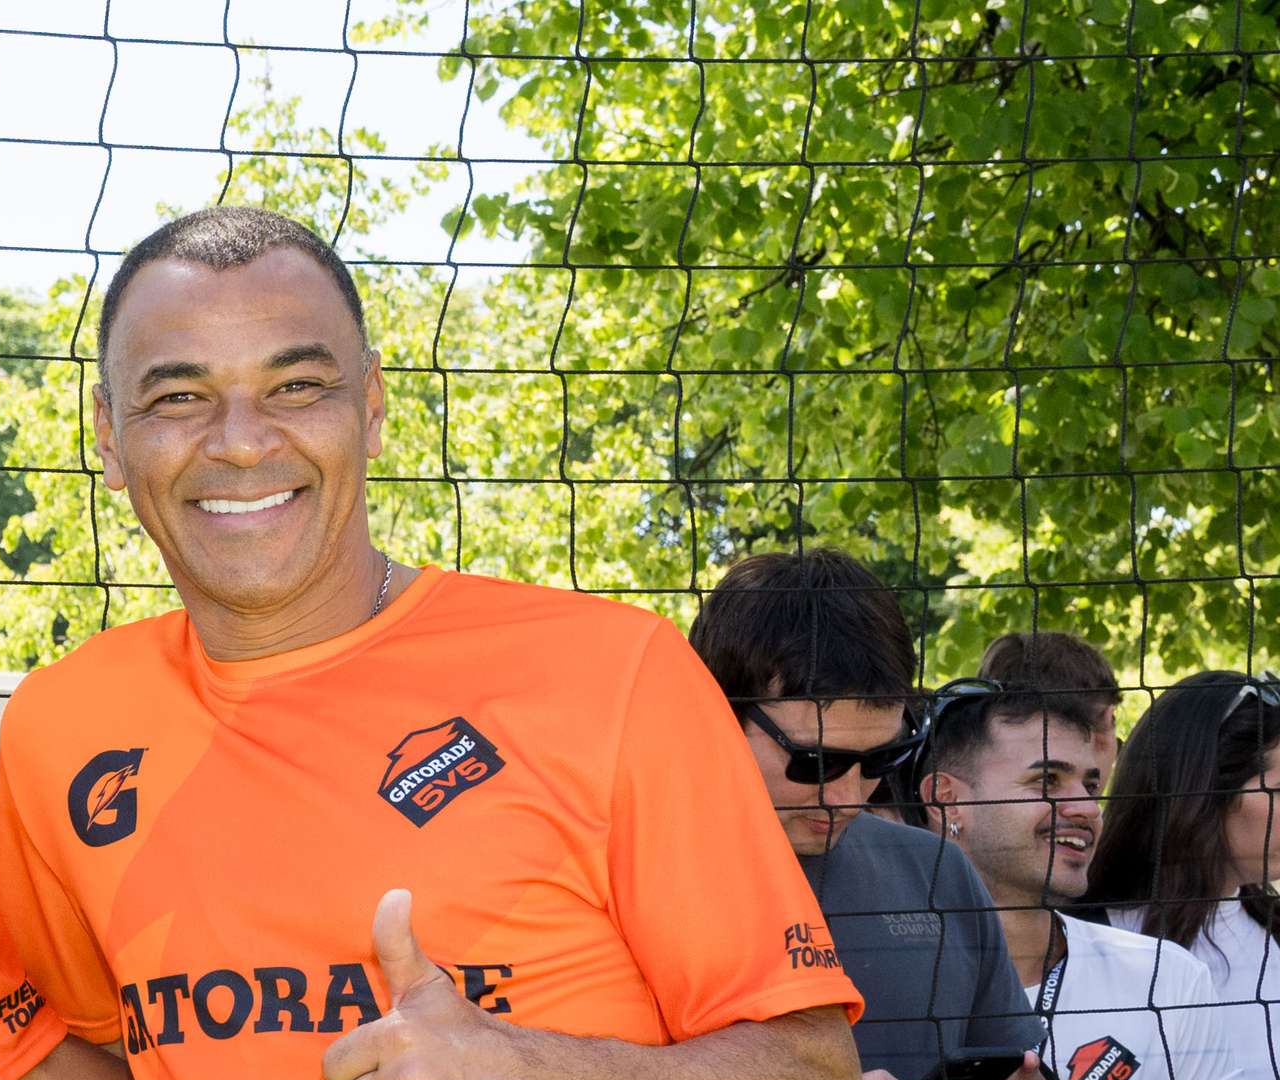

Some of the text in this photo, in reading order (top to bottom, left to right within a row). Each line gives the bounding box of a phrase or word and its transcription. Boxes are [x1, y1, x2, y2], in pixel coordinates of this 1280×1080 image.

[389, 735, 476, 803] GATORADE
[889, 924, 941, 937] COMPAN
[121, 963, 512, 1055] ATORAE
